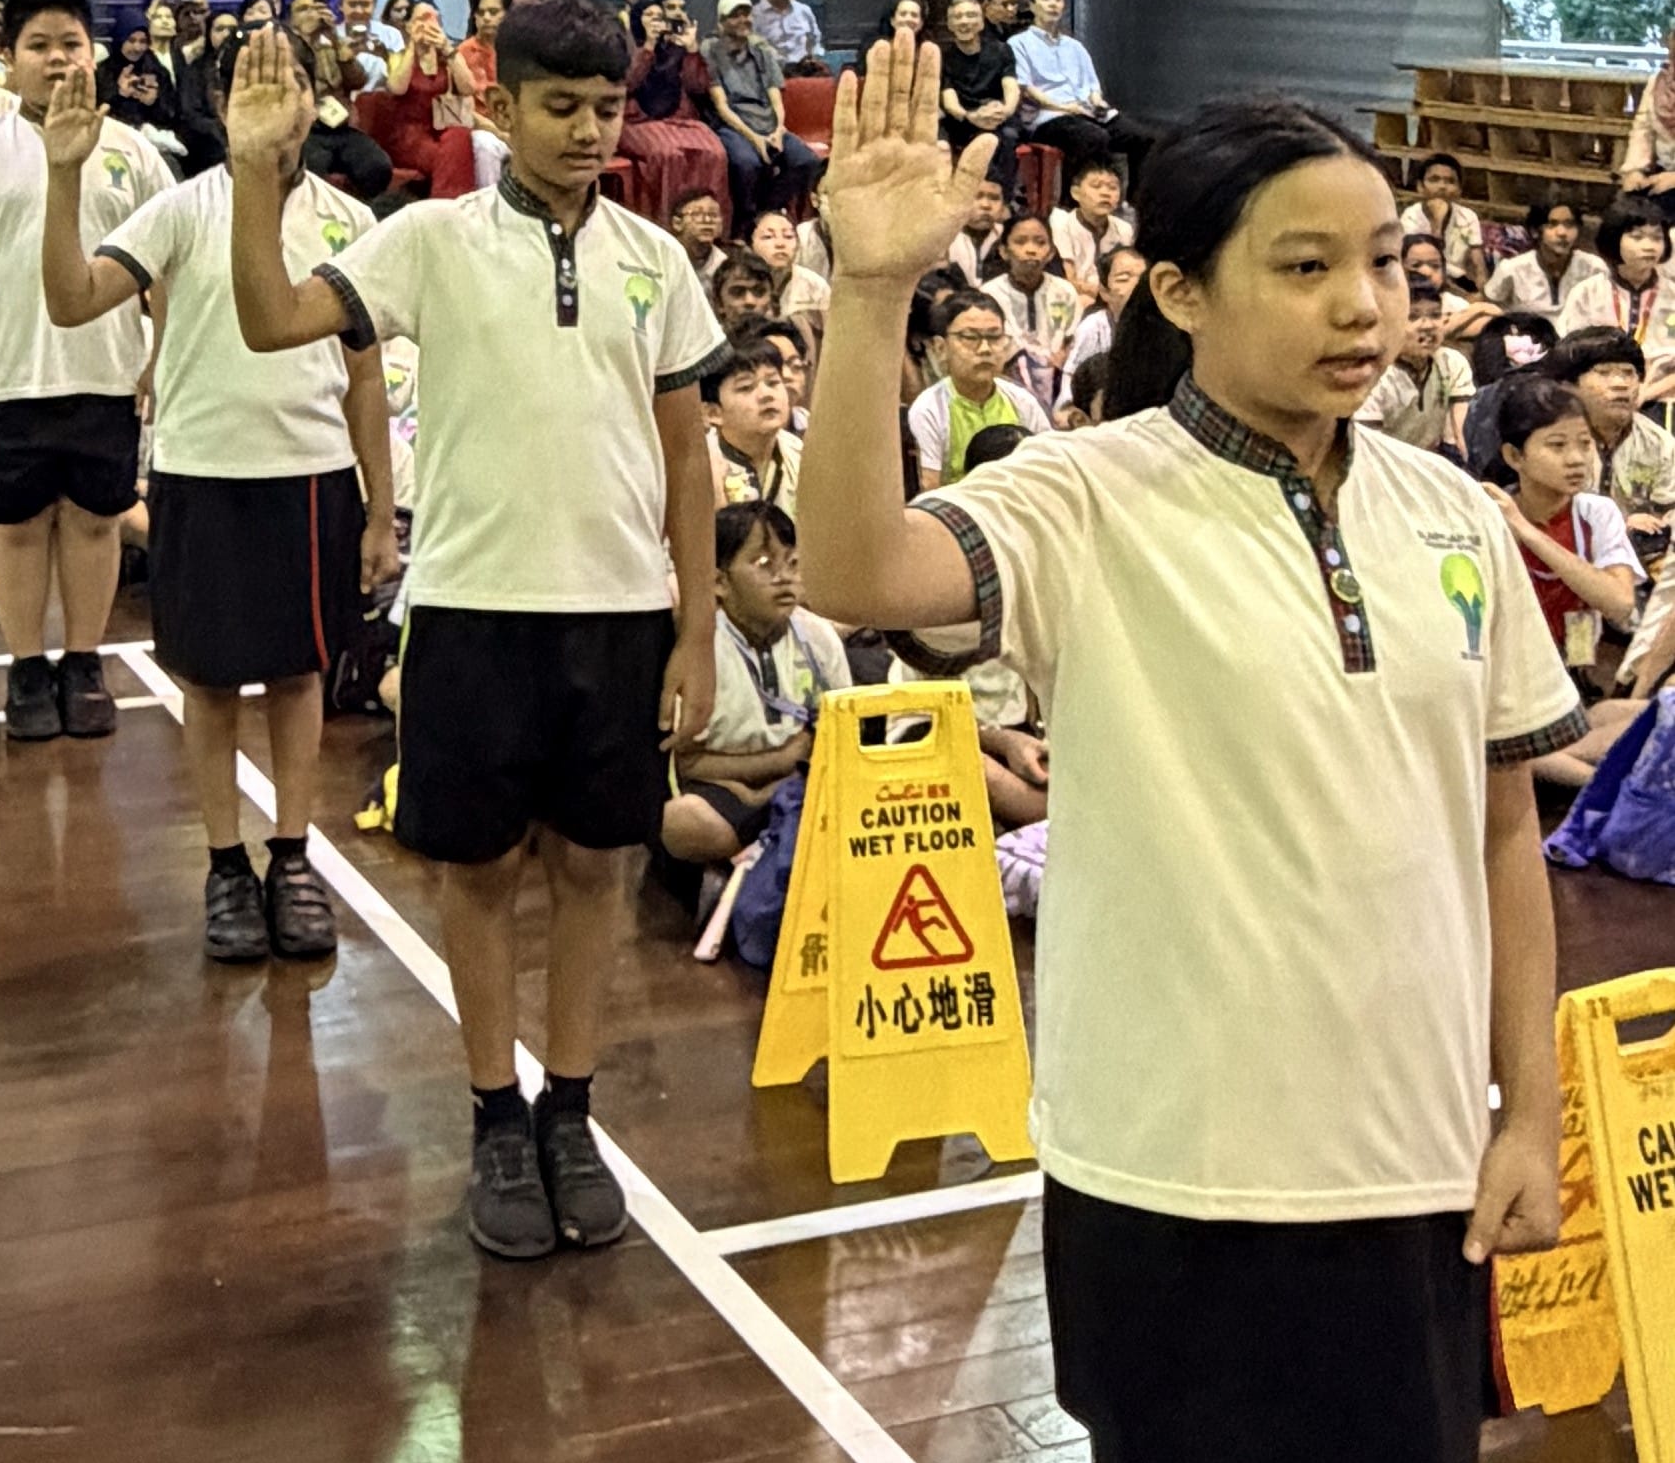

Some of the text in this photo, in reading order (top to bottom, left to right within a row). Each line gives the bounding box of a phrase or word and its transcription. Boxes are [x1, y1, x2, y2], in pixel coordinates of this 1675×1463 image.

[860, 800, 962, 830] CAUTION
[848, 827, 976, 858] WET FLOOR
[855, 971, 997, 1040] 小心地滑
[1637, 1120, 1675, 1166] CA
